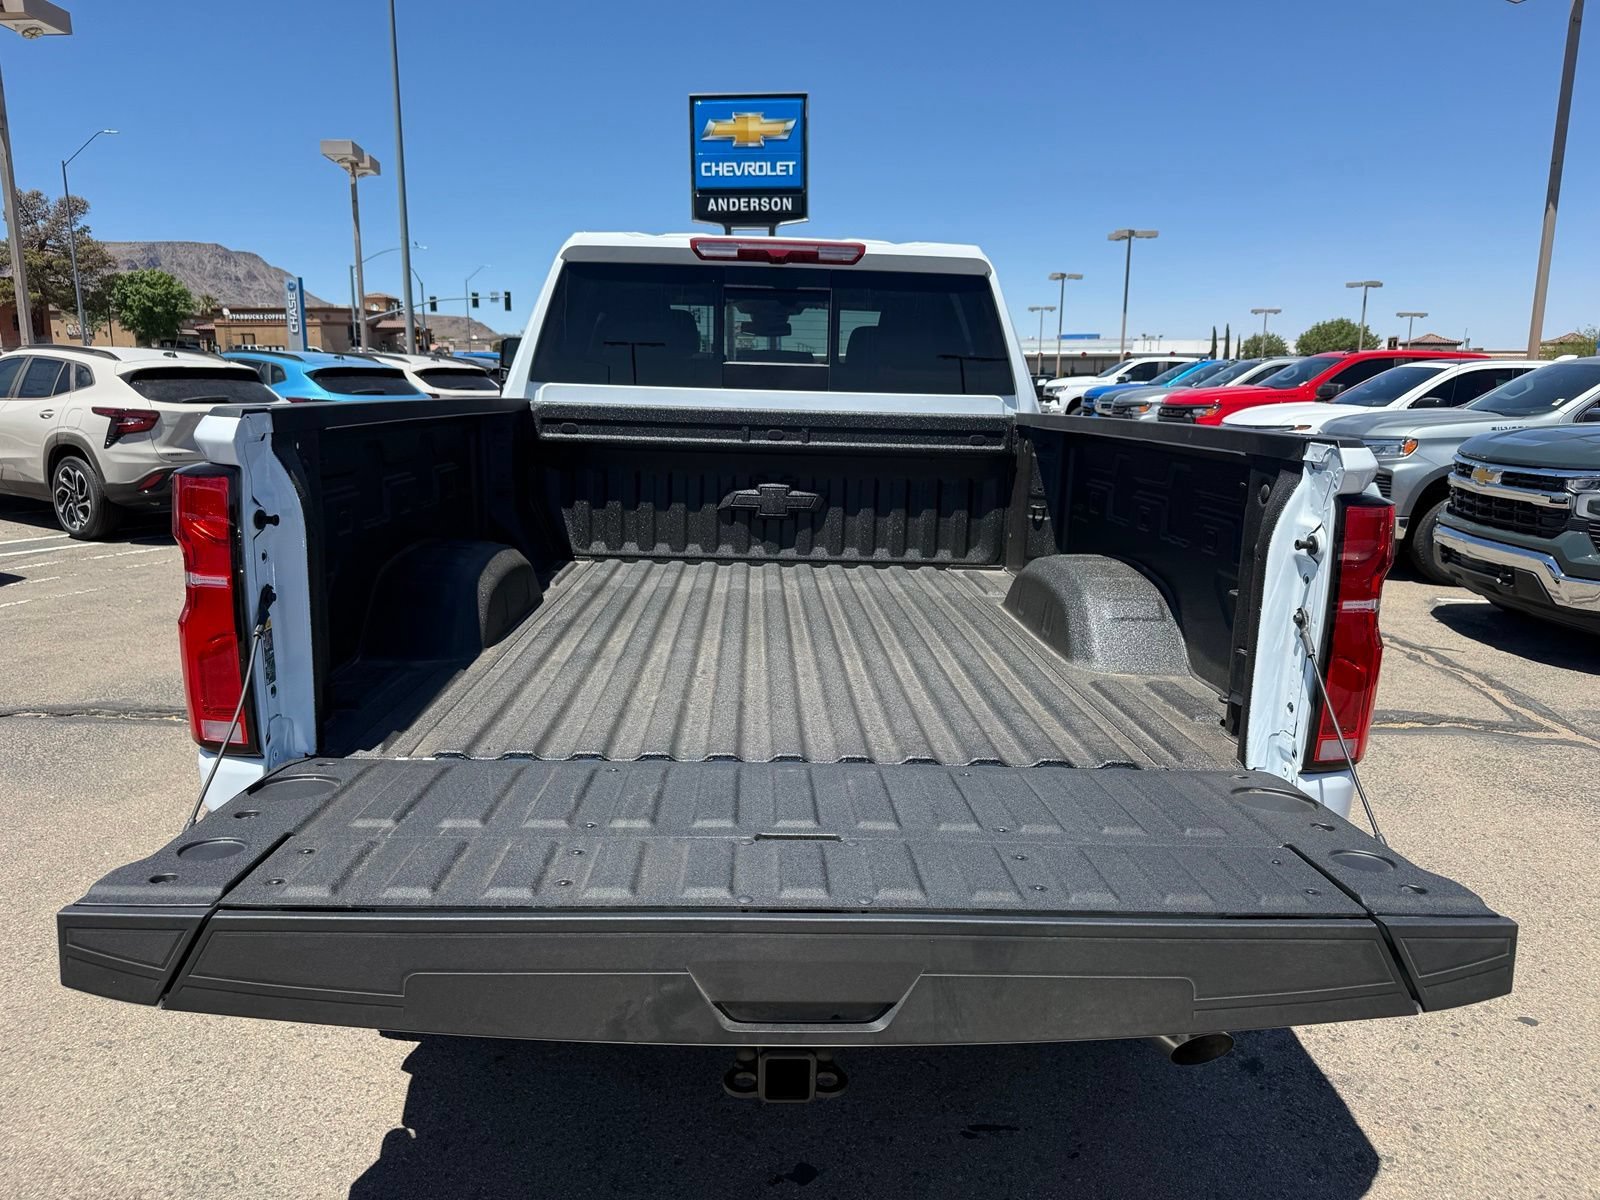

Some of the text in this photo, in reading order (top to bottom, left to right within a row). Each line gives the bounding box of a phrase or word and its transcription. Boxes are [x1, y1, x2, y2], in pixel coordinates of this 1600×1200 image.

[701, 161, 796, 176] CHEVROLET
[707, 197, 793, 211] ANDERSON
[287, 292, 299, 333] CHASE
